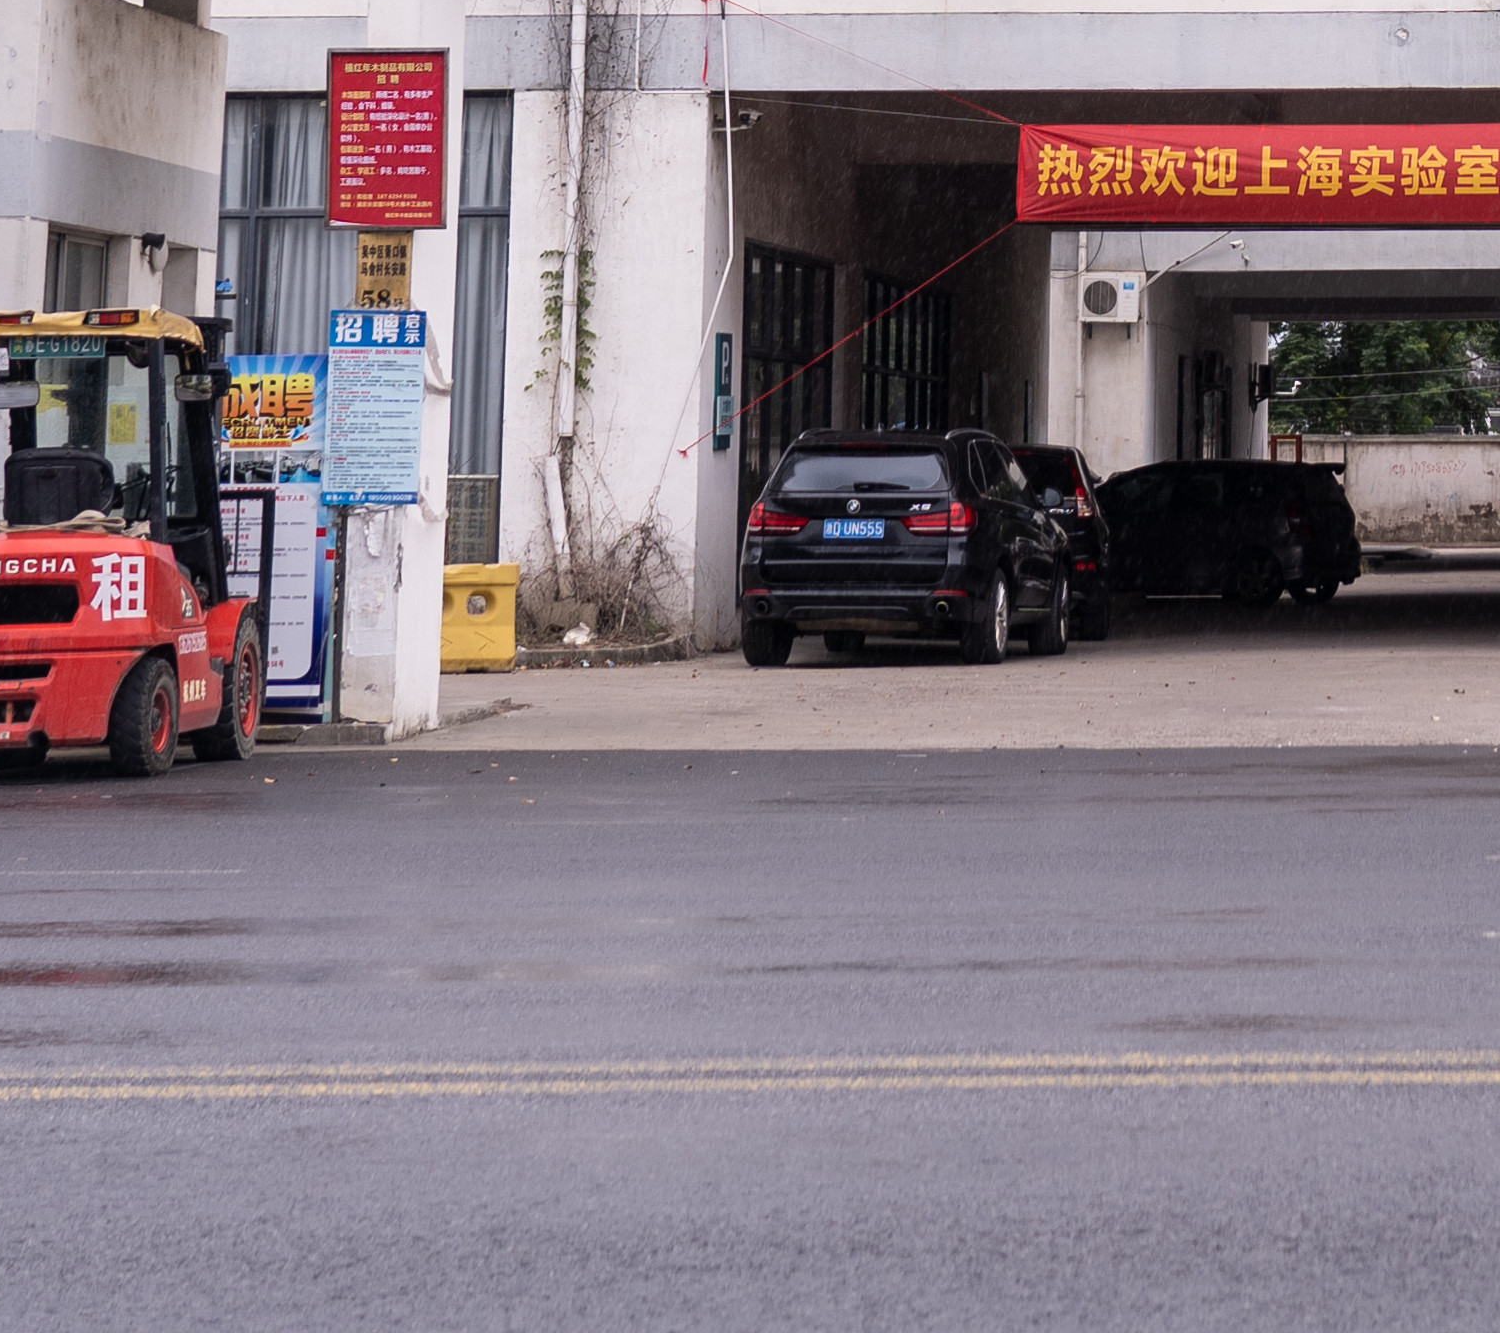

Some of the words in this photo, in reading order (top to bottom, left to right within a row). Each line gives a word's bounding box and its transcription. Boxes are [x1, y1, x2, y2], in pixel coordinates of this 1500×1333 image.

[335, 313, 400, 344] 招聘
[220, 416, 314, 427] ECRUITMENT
[90, 552, 148, 623] 租
